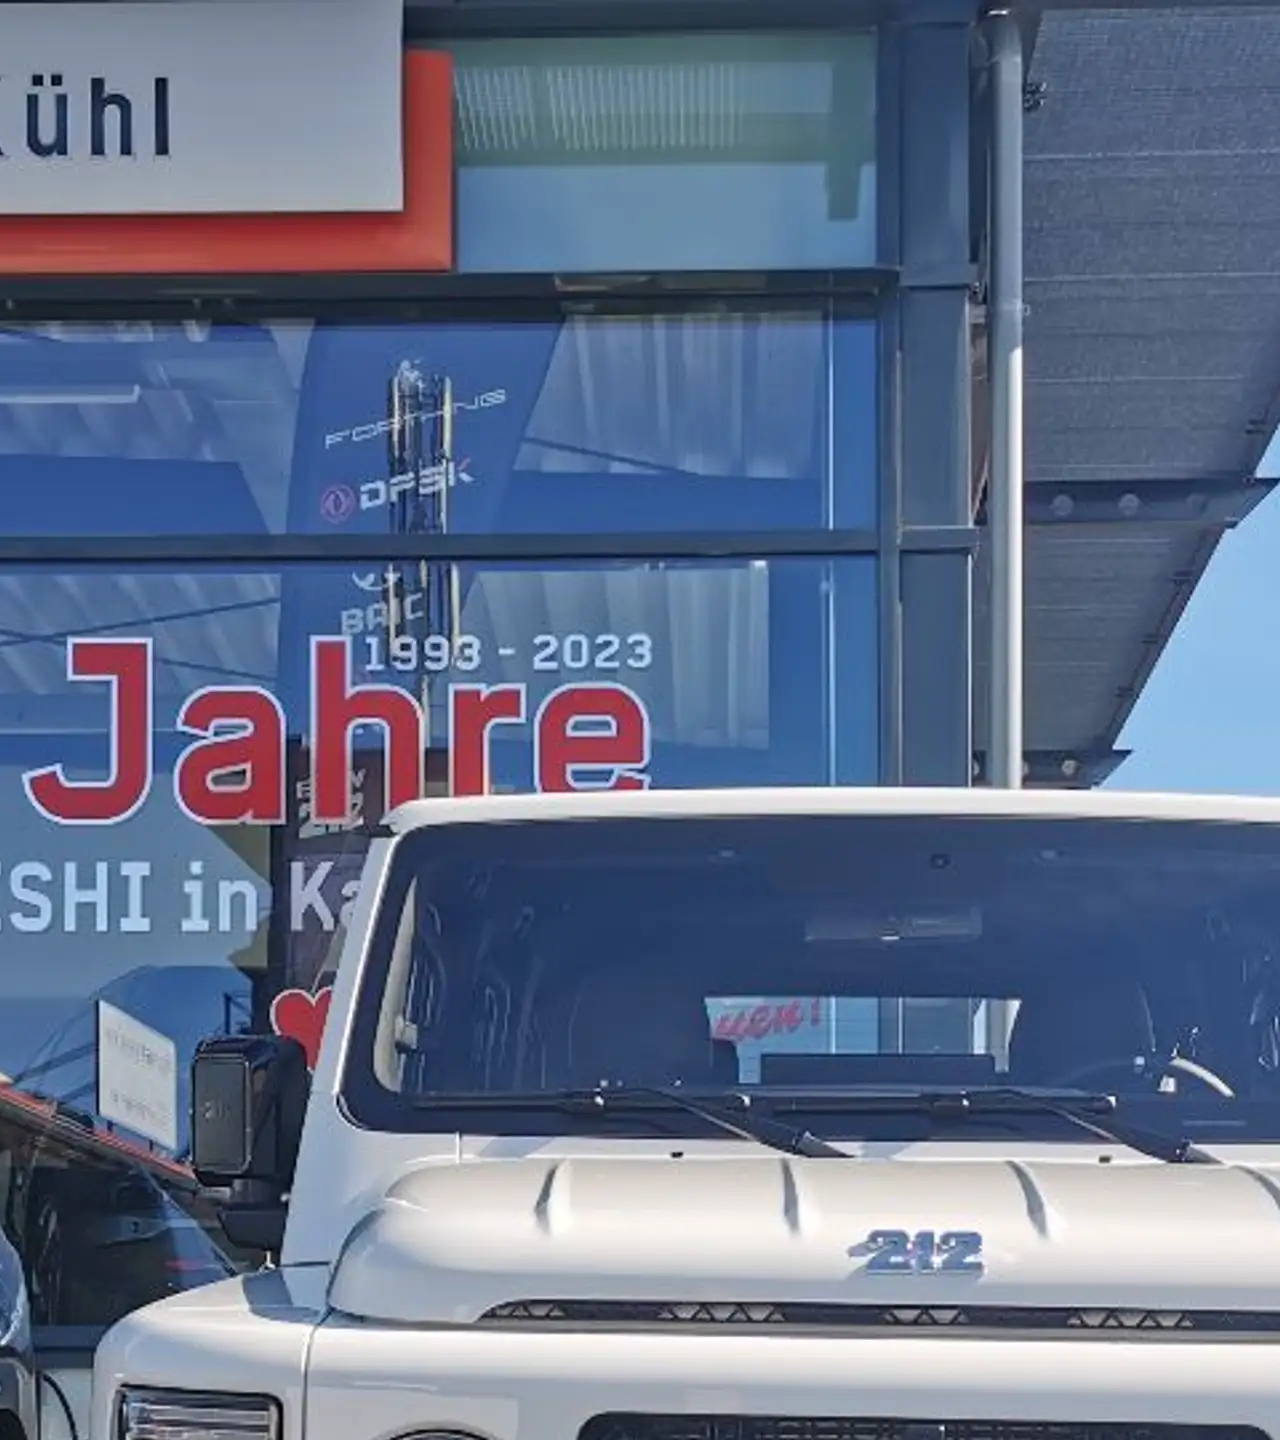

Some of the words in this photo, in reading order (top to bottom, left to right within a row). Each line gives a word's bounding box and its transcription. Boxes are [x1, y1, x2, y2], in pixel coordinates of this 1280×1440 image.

[359, 460, 477, 510] DFSK
[364, 633, 482, 671] 1993
[532, 633, 654, 670] 2023
[23, 636, 652, 825] Jahre
[182, 862, 258, 932] in
[847, 1229, 984, 1275] 212
